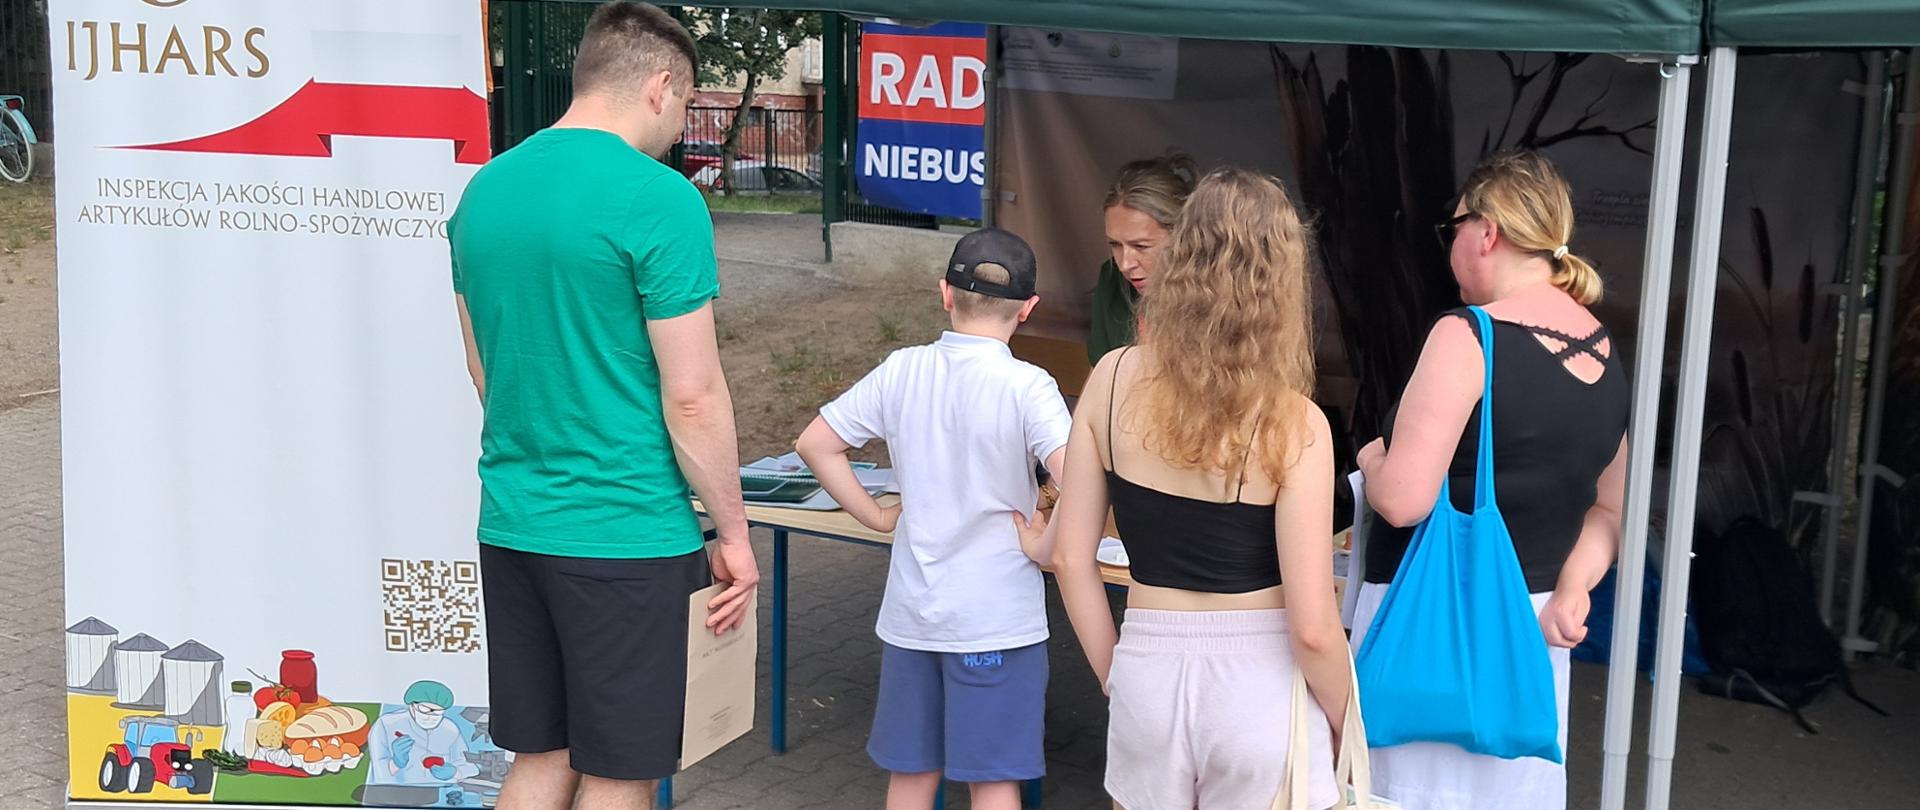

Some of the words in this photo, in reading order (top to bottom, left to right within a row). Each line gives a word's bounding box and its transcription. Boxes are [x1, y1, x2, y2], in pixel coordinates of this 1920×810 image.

[66, 20, 270, 81] IJHARS
[870, 51, 987, 109] RAD
[864, 143, 985, 185] NIEBUS
[78, 202, 211, 229] ARTYKUŁÓW
[98, 177, 208, 204] INSPEKCJA
[214, 180, 304, 207] JAKOŚCI
[313, 187, 445, 216] HANDLOWEJ
